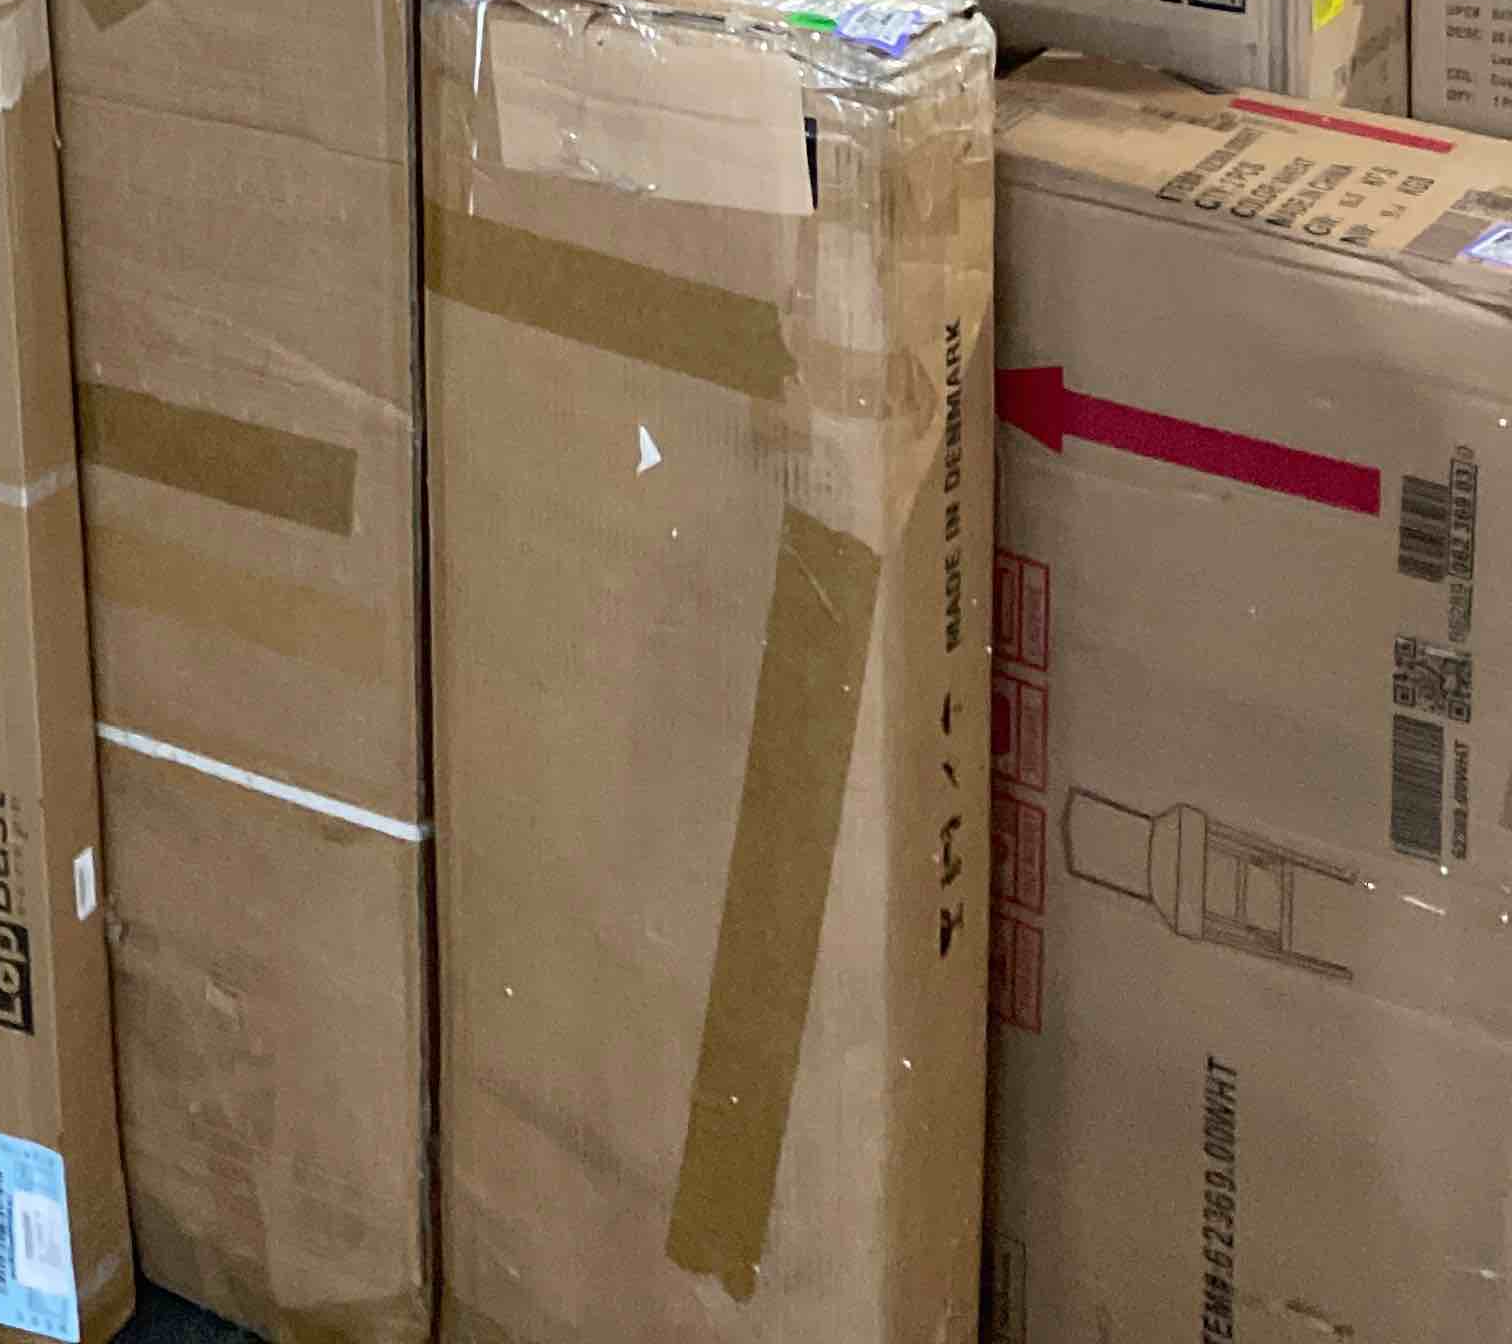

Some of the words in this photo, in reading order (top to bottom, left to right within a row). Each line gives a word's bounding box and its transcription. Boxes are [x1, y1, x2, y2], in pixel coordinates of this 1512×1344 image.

[943, 318, 963, 494] DENMARK
[943, 510, 961, 547] IN
[943, 553, 962, 653] MADE
